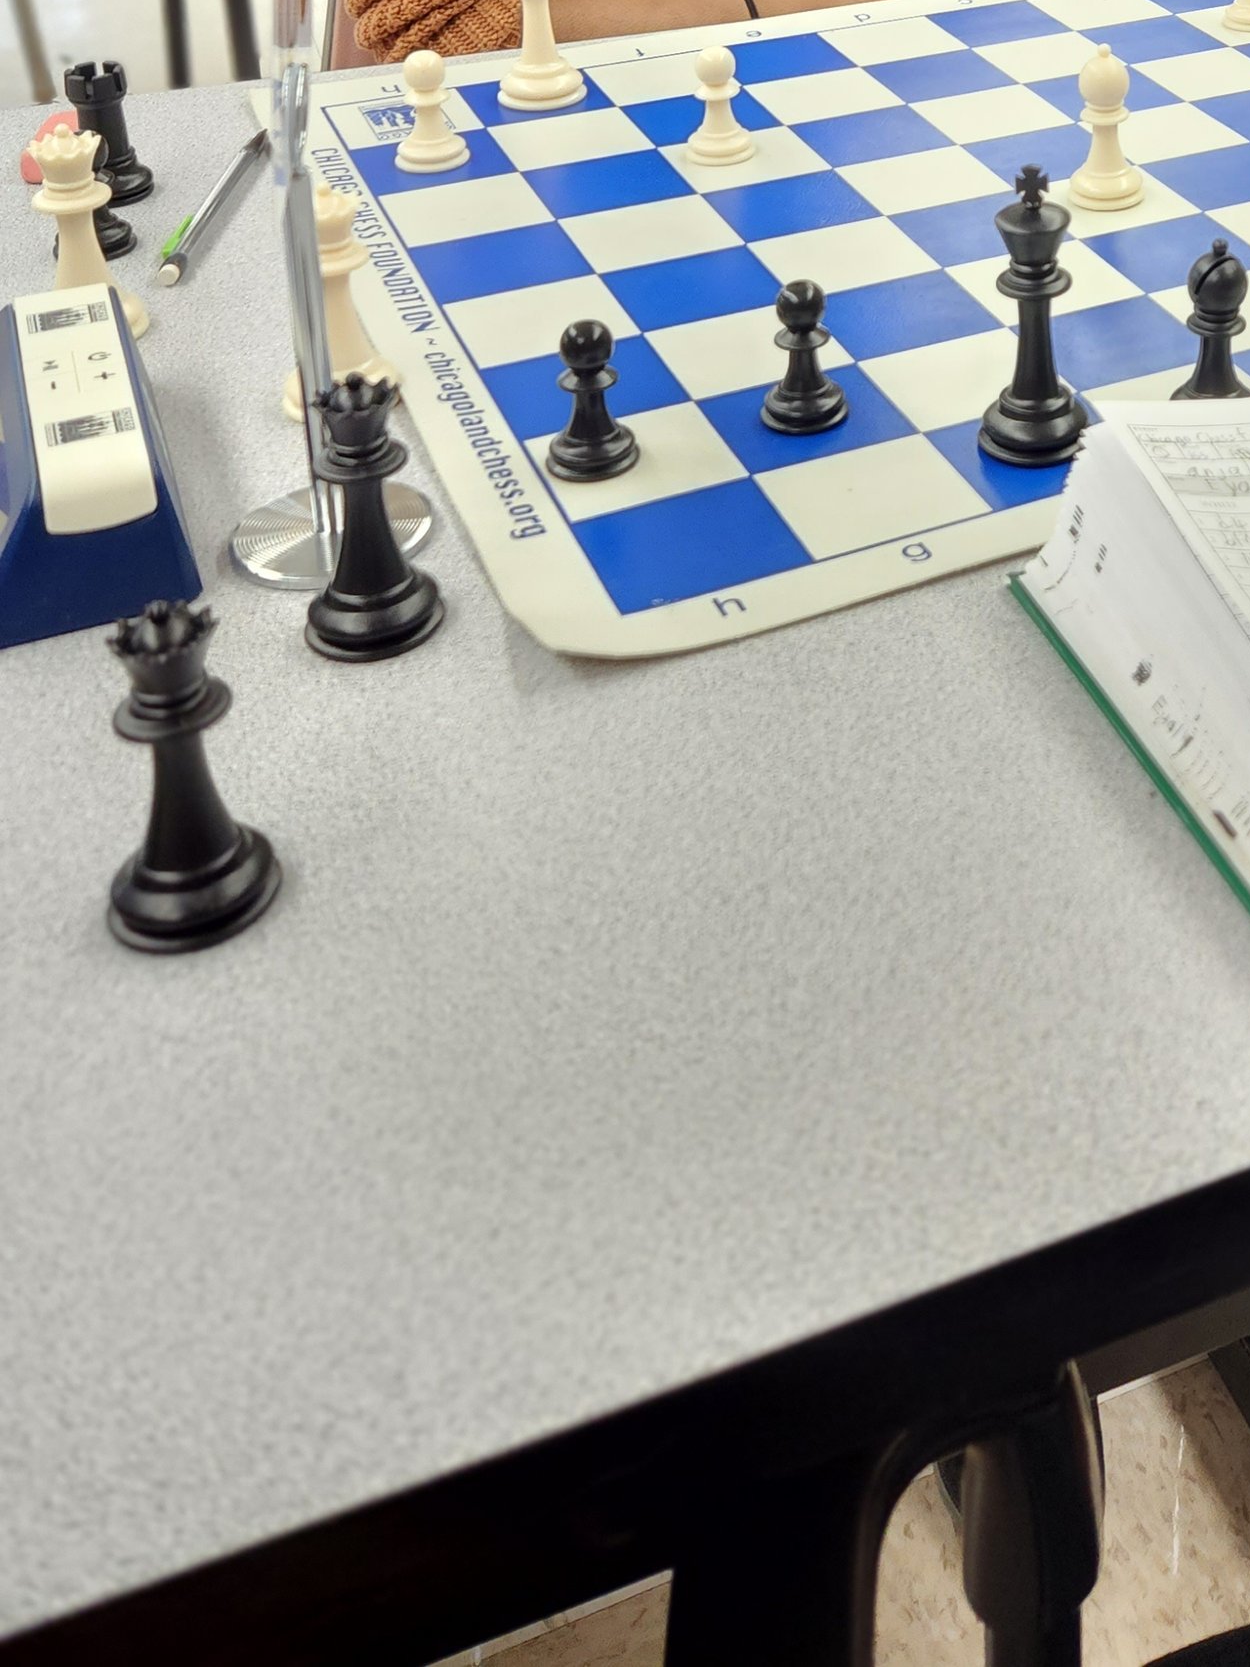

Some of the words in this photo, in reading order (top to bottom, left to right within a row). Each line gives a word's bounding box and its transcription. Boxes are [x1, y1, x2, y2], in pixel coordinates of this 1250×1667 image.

[366, 241, 441, 335] FOUNDATION
[424, 351, 547, 539] chicagolandchess.org
[711, 597, 747, 617] h
[901, 541, 932, 562] g
